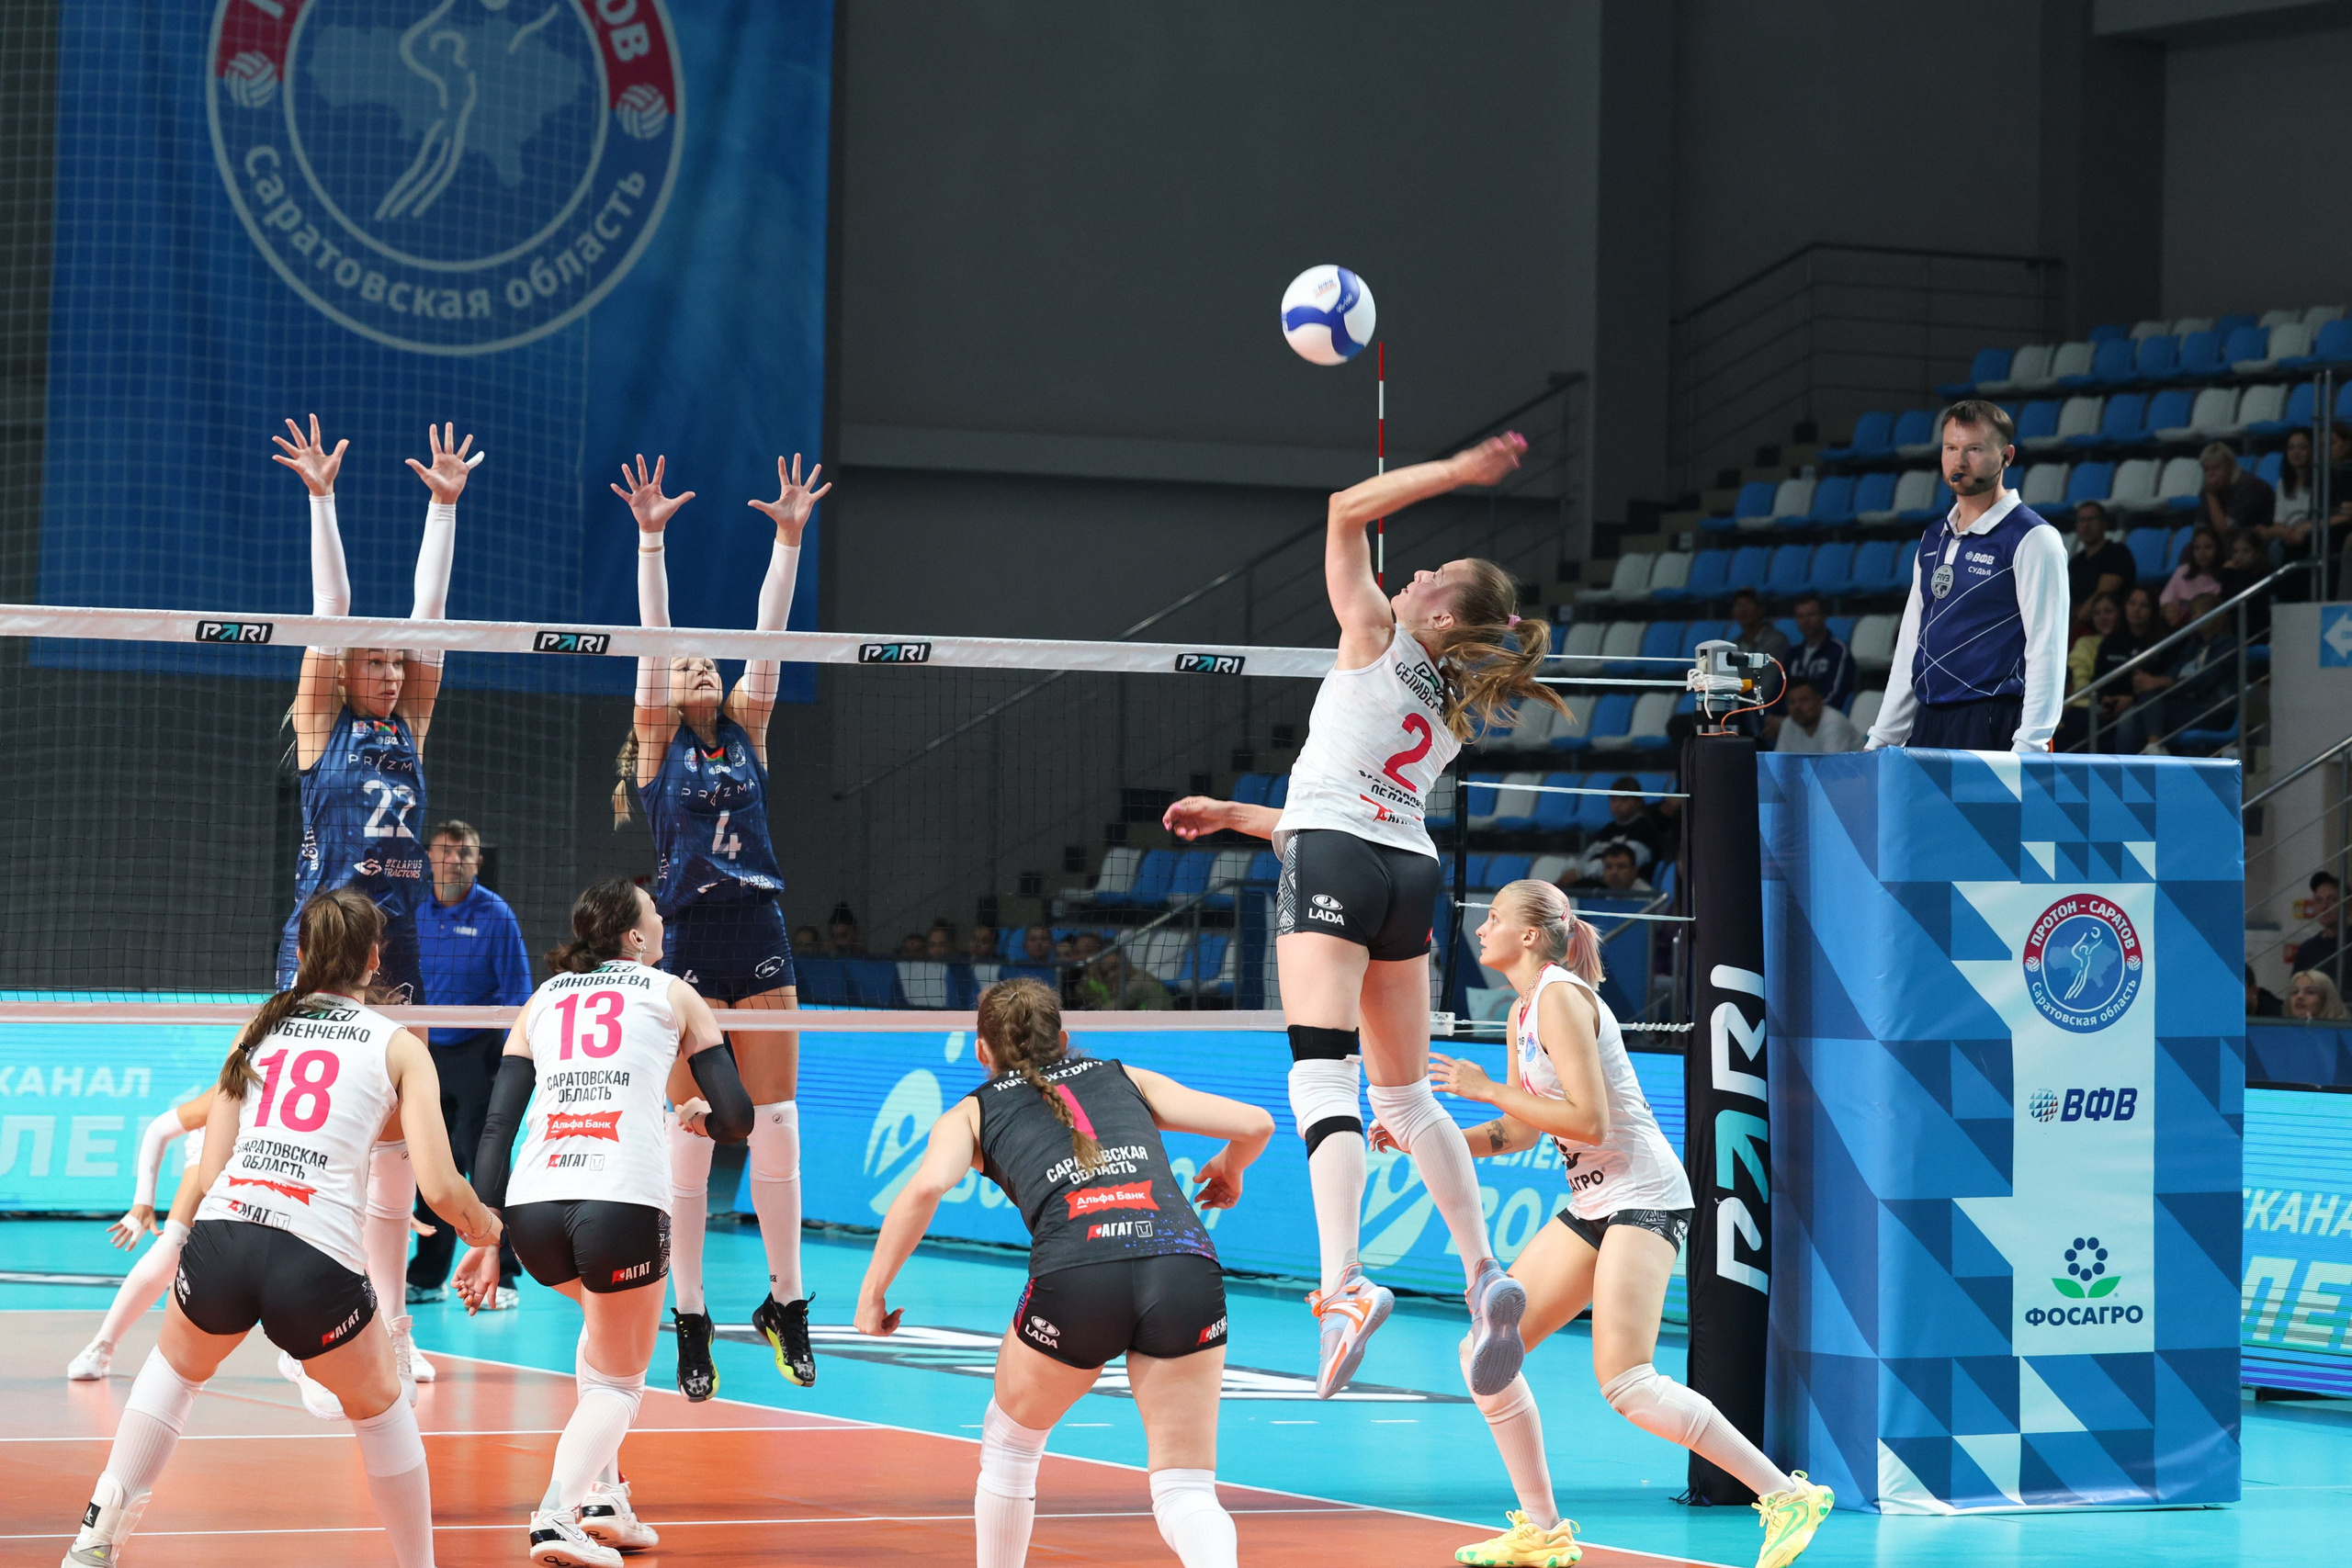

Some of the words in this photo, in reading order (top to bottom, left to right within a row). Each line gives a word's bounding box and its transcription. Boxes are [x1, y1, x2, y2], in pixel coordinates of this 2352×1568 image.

[244, 145, 492, 320] Саратовская
[505, 172, 645, 309] область
[1972, 552, 1996, 565] ВФВ
[1968, 566, 1992, 576] СУДЬЯ
[200, 623, 268, 642] PARI
[539, 632, 607, 652] PARI
[864, 644, 926, 661] PARI
[1180, 655, 1240, 674] PARI
[1383, 712, 1432, 793] 2
[363, 779, 416, 838] 22
[712, 810, 742, 860] 4
[384, 868, 421, 879] TRACTORS
[385, 859, 423, 869] BELARUS
[1308, 908, 1345, 926] LADA
[2030, 900, 2077, 947] ПРОТОН
[2089, 900, 2136, 950] САРАТОВ
[548, 975, 651, 992] ЗИНОВЬЕВА
[2031, 981, 2098, 1026] Саратовская
[2099, 979, 2137, 1021] область
[266, 1021, 371, 1043] УБЕНЧЕНКО
[554, 990, 625, 1061] 13
[254, 1048, 340, 1133] 18
[547, 1070, 630, 1091] САРАТОВСКАЯ
[558, 1086, 612, 1103] ОБЛАСТЬ
[2061, 1087, 2138, 1122] ВФВ
[551, 1119, 584, 1131] Альфа
[585, 1119, 612, 1129] Банк
[1710, 964, 1769, 1296] PARI
[243, 1155, 305, 1180] ОБЛАСТЬ
[559, 1154, 589, 1168] АГАТ
[1046, 1145, 1149, 1183] САРАОВСКАЯ
[1566, 1169, 1604, 1193] АГРО
[1077, 1193, 1116, 1207] Альфа
[1117, 1190, 1147, 1201] Банк
[239, 1202, 272, 1224] АГАТ
[2243, 1186, 2352, 1236] КАНА
[1102, 1222, 1133, 1237] АГАТ
[625, 1261, 650, 1280] АГАТ
[334, 1308, 360, 1338] АГАТ
[2025, 1304, 2143, 1326] ФОСАГРО
[1024, 1323, 1058, 1349] LADA
